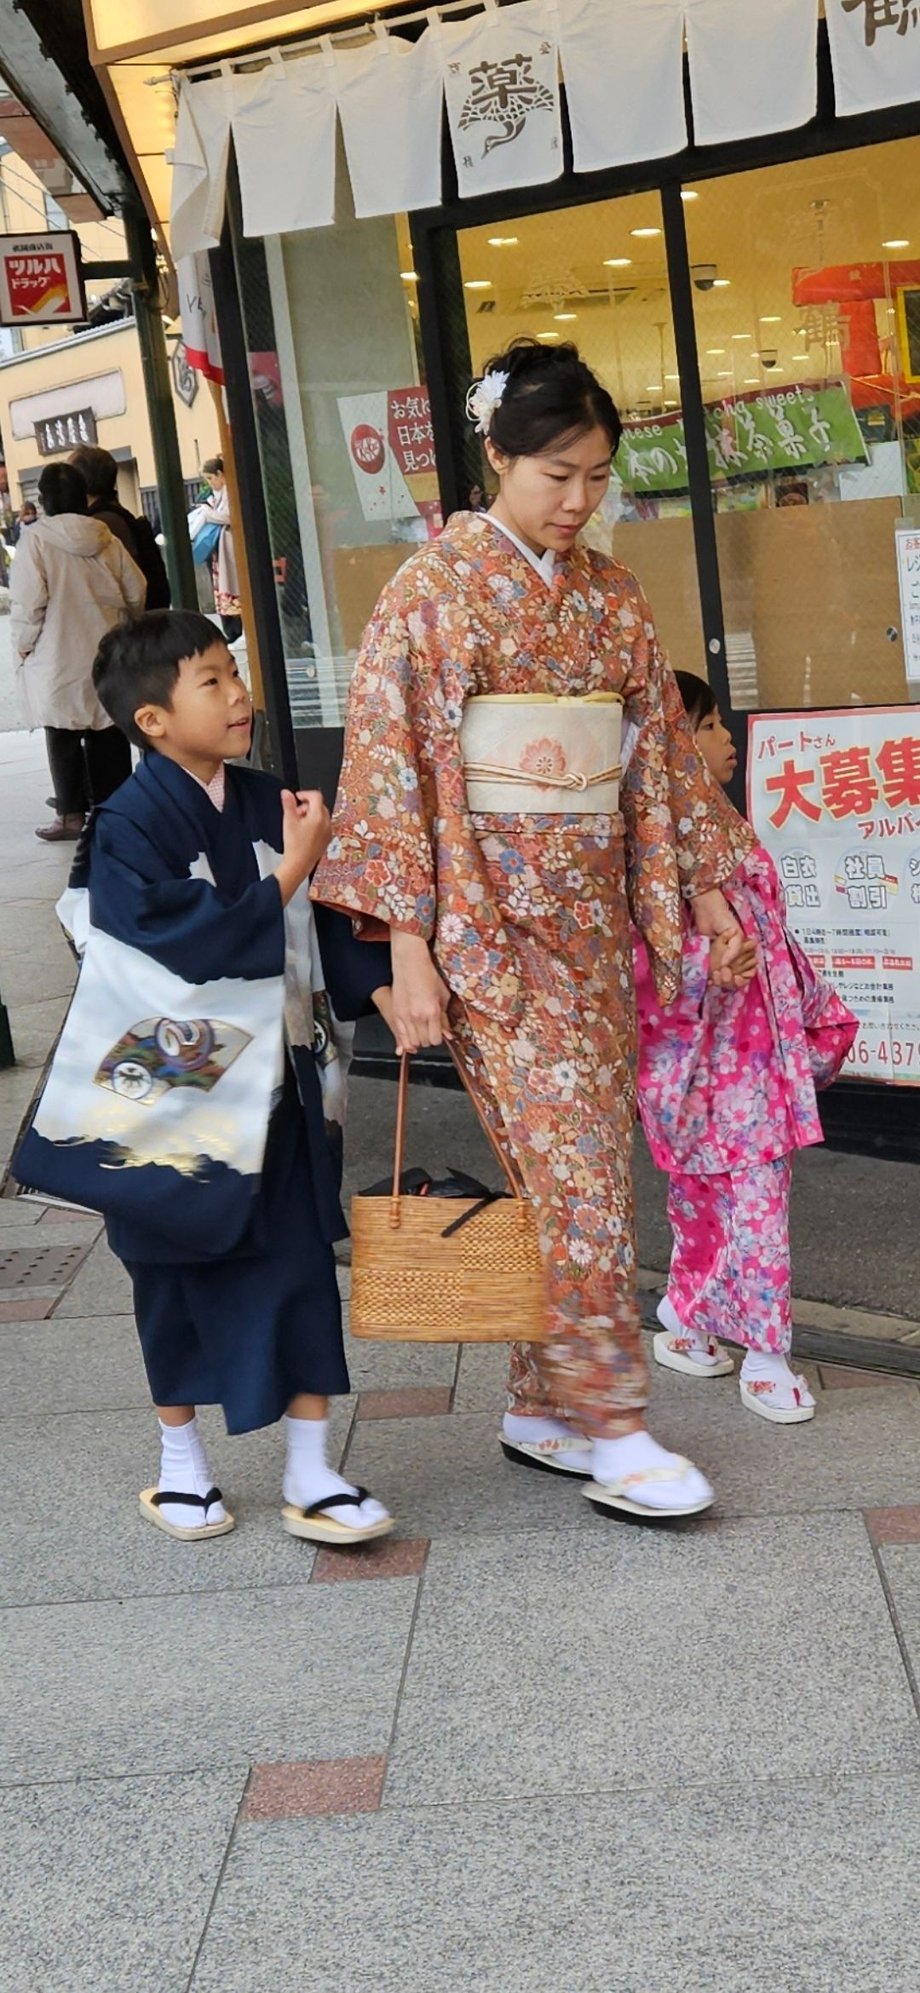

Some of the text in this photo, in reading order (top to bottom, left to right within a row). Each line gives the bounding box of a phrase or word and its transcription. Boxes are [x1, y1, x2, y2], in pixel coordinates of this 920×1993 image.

[468, 53, 537, 113] 薬
[9, 257, 61, 275] ツルハ
[12, 277, 50, 289] ドラッグ
[619, 425, 662, 441] nese
[758, 731, 836, 760] パートさん
[766, 736, 920, 829] 大募集
[781, 855, 816, 879] 白衣
[845, 855, 885, 880] 社員
[847, 885, 887, 909] 割引
[847, 1040, 920, 1066] 06-437
